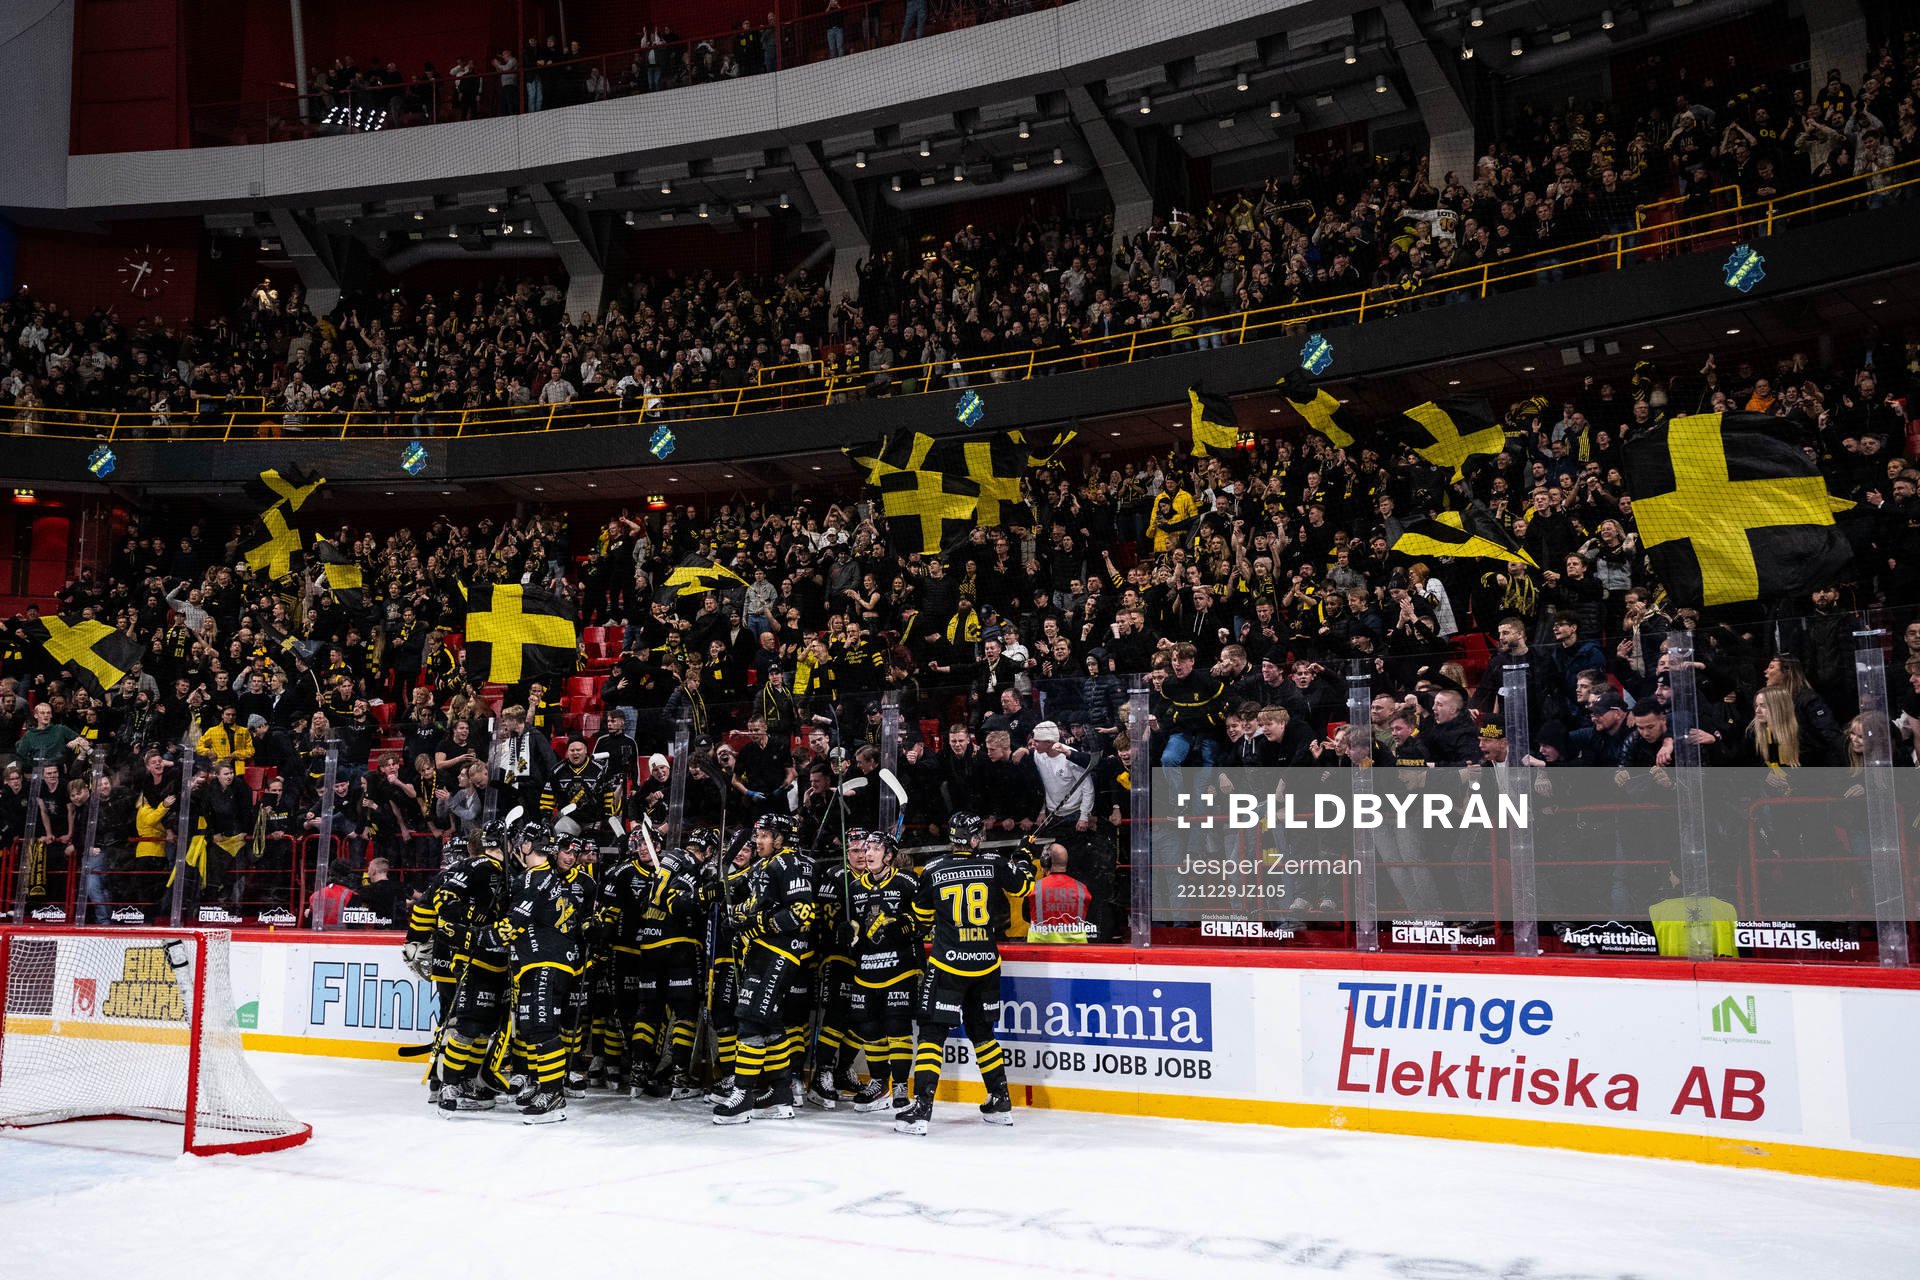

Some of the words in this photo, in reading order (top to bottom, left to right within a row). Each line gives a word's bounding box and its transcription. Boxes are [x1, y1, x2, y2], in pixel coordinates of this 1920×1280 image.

[934, 865, 993, 884] Bemannia
[1045, 887, 1077, 902] FIRE
[790, 902, 812, 920] 26
[940, 882, 990, 928] 78
[1030, 920, 1098, 935] Ångtvättbilen
[1735, 920, 1771, 928] Stockholm
[1771, 921, 1796, 929] Bilglas
[1563, 927, 1656, 946] Ångtvättbilen
[102, 980, 186, 1022] JACKPO
[760, 974, 778, 1016] JÄRFÄLLA
[887, 991, 910, 999] ATM
[538, 1005, 547, 1023] KÖK
[994, 987, 1204, 1044] mannia
[1338, 982, 1554, 1045] Tullinge
[944, 1045, 969, 1065] BB
[1002, 1047, 1026, 1068] BB
[1033, 1049, 1086, 1072] JOBB
[1092, 1053, 1148, 1076] JOBB
[1155, 1057, 1213, 1080] JOBB
[1336, 1045, 1640, 1112] Elektriska
[1670, 1065, 1767, 1122] AB
